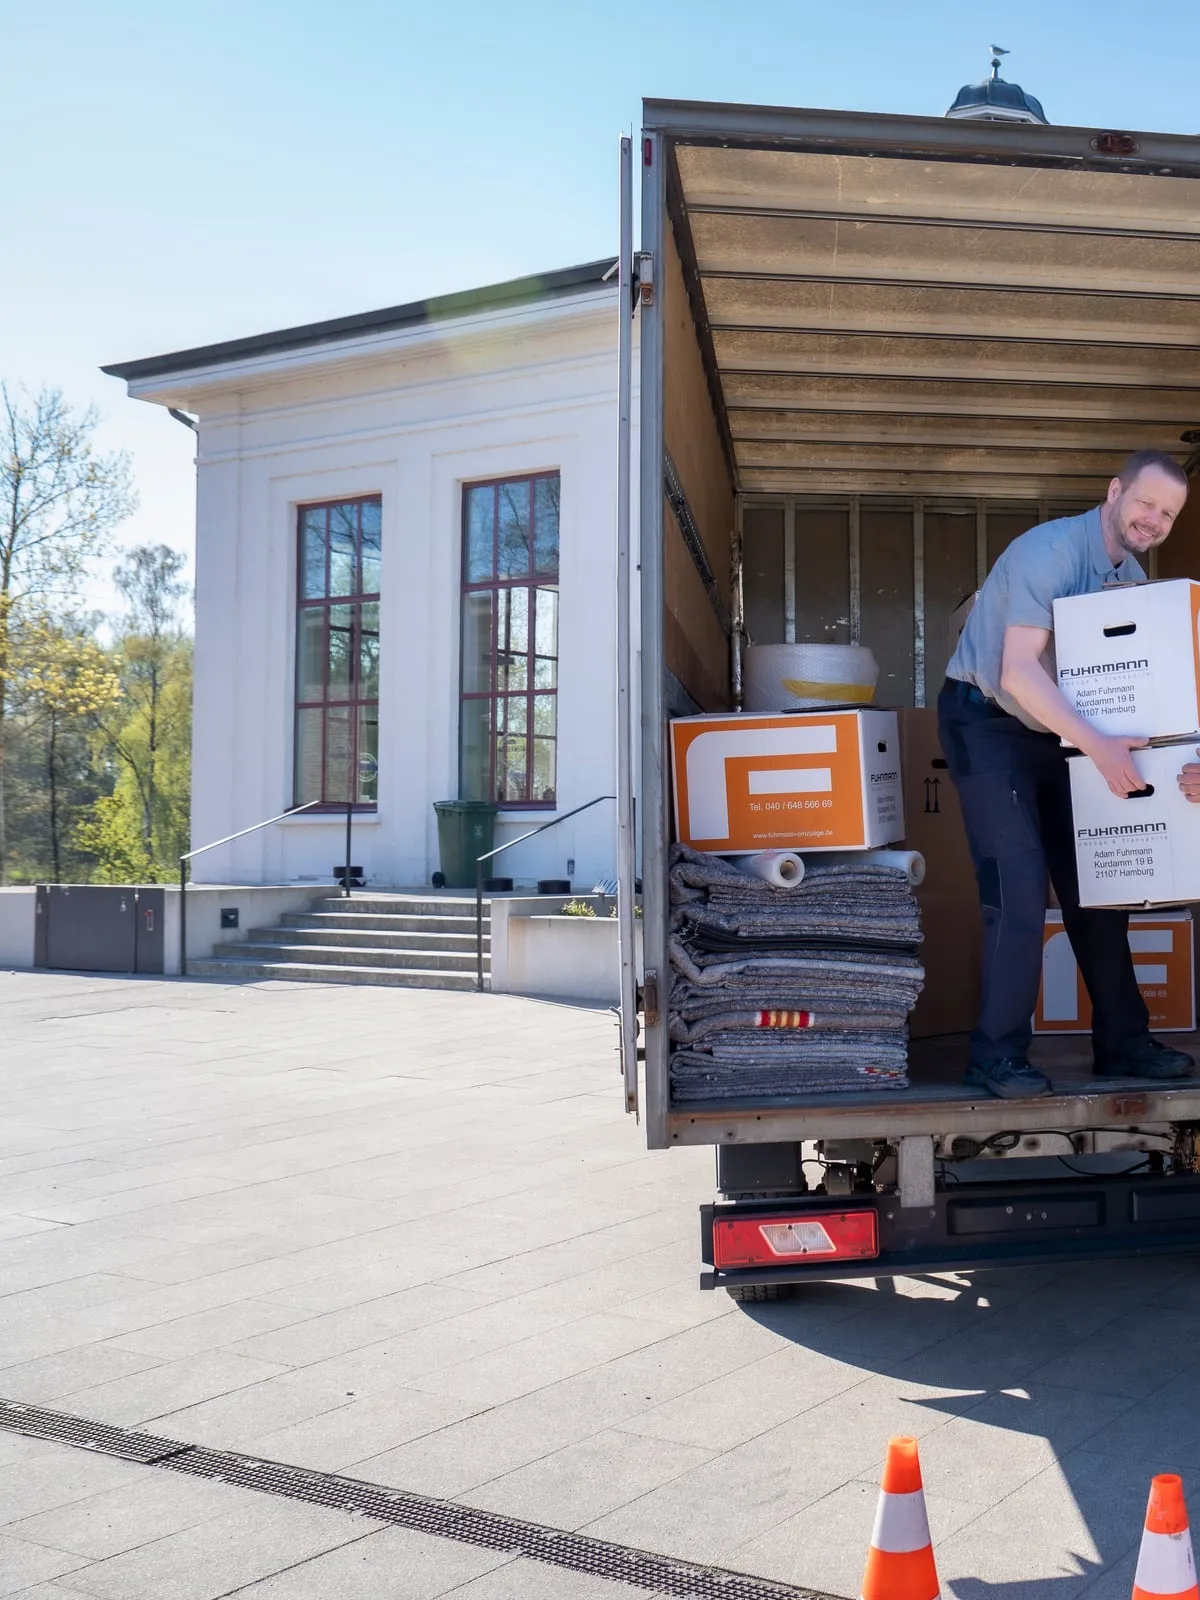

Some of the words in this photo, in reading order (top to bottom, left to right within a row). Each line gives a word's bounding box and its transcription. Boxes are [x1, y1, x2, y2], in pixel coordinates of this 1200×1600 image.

[1060, 659, 1148, 678] FUHRMANN
[1076, 690, 1097, 698] Adam
[1099, 685, 1135, 695] Fuhrmann
[1076, 697, 1114, 708] Kurdamm
[1117, 695, 1127, 703] 19
[1101, 705, 1136, 715] Hamburg
[749, 803, 763, 811] Tel.
[765, 802, 780, 810] 040
[787, 801, 803, 810] 648
[804, 800, 820, 809] 566
[822, 799, 833, 808] 69
[1078, 822, 1166, 838] FUHRMANN
[1094, 850, 1115, 859] Adam
[1117, 848, 1153, 857] Fuhrmann
[1094, 859, 1132, 869] Kurdamm
[1135, 857, 1145, 866] 19
[1147, 856, 1153, 864] B
[1095, 869, 1118, 878] 21107
[1120, 868, 1154, 877] Hamburg
